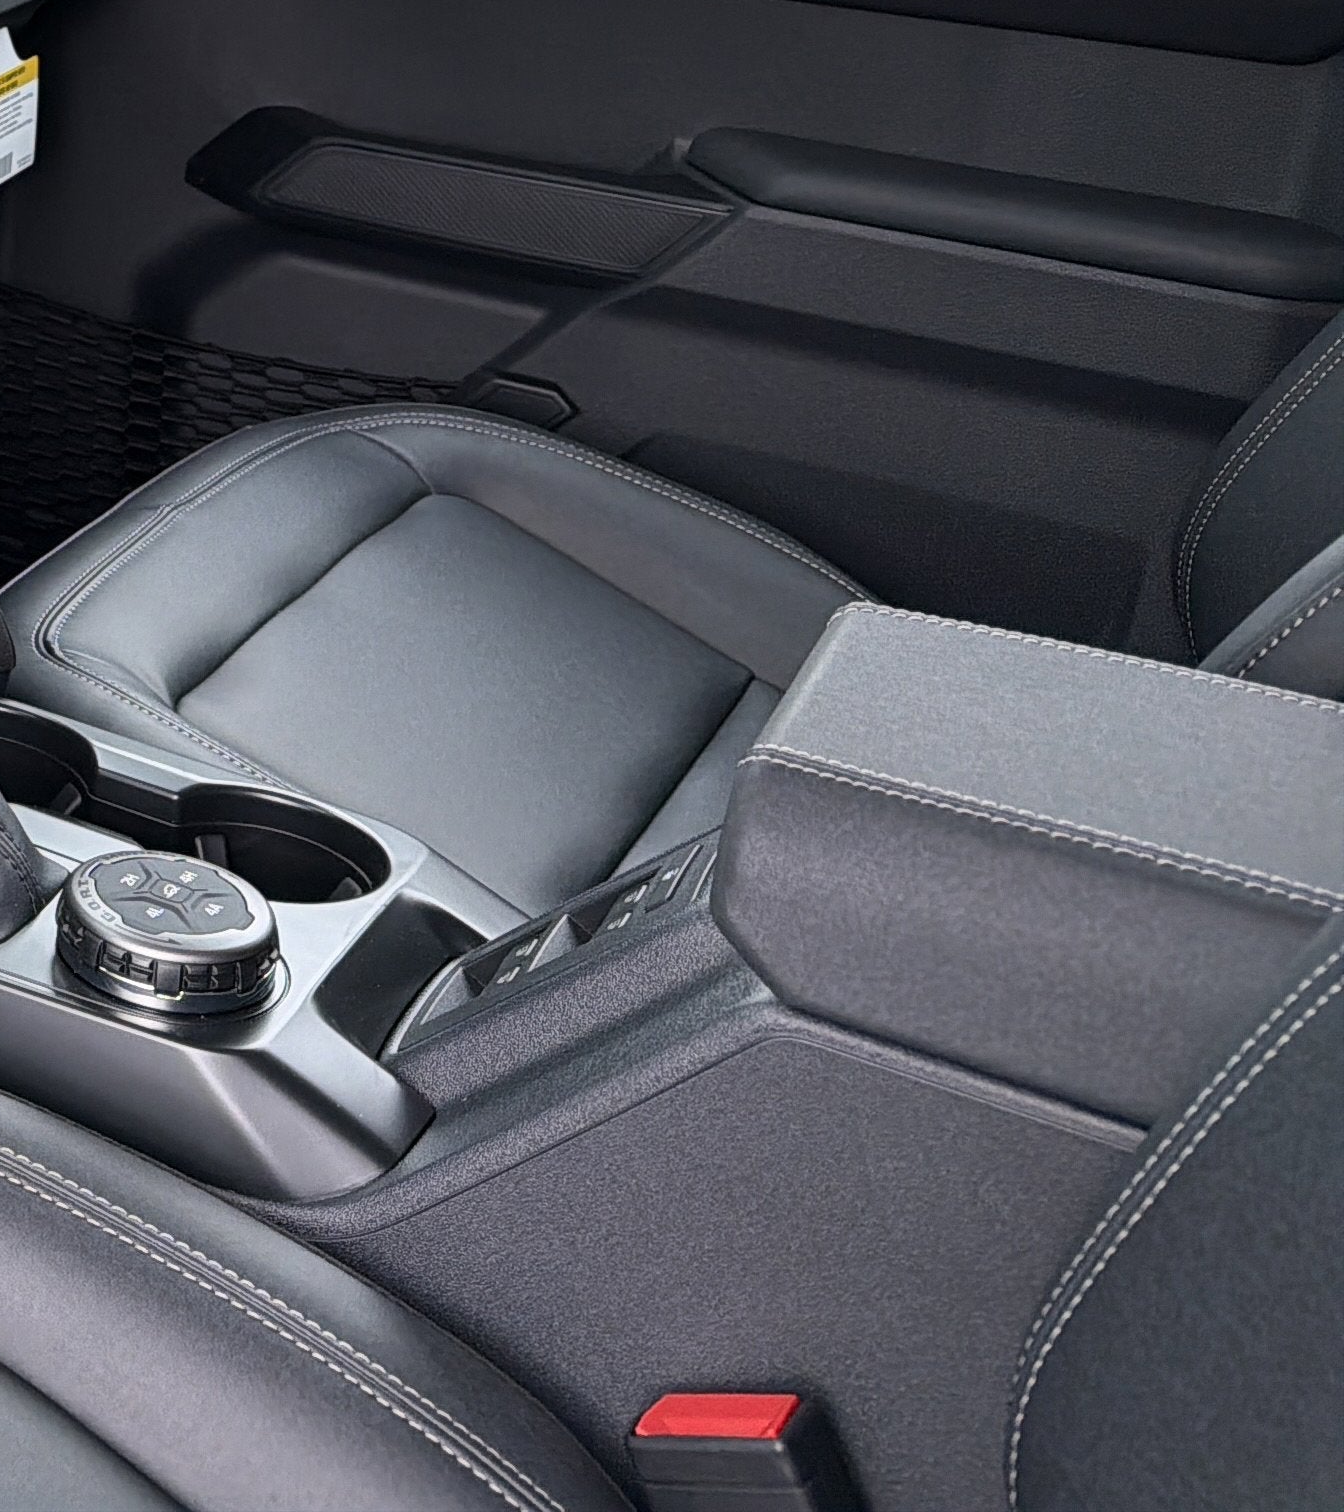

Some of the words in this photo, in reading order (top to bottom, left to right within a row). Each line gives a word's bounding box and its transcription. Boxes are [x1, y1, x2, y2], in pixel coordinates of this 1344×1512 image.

[119, 872, 140, 887] 2H
[179, 870, 199, 884] 4H
[145, 906, 165, 919] 4L
[204, 902, 225, 917] 4A
